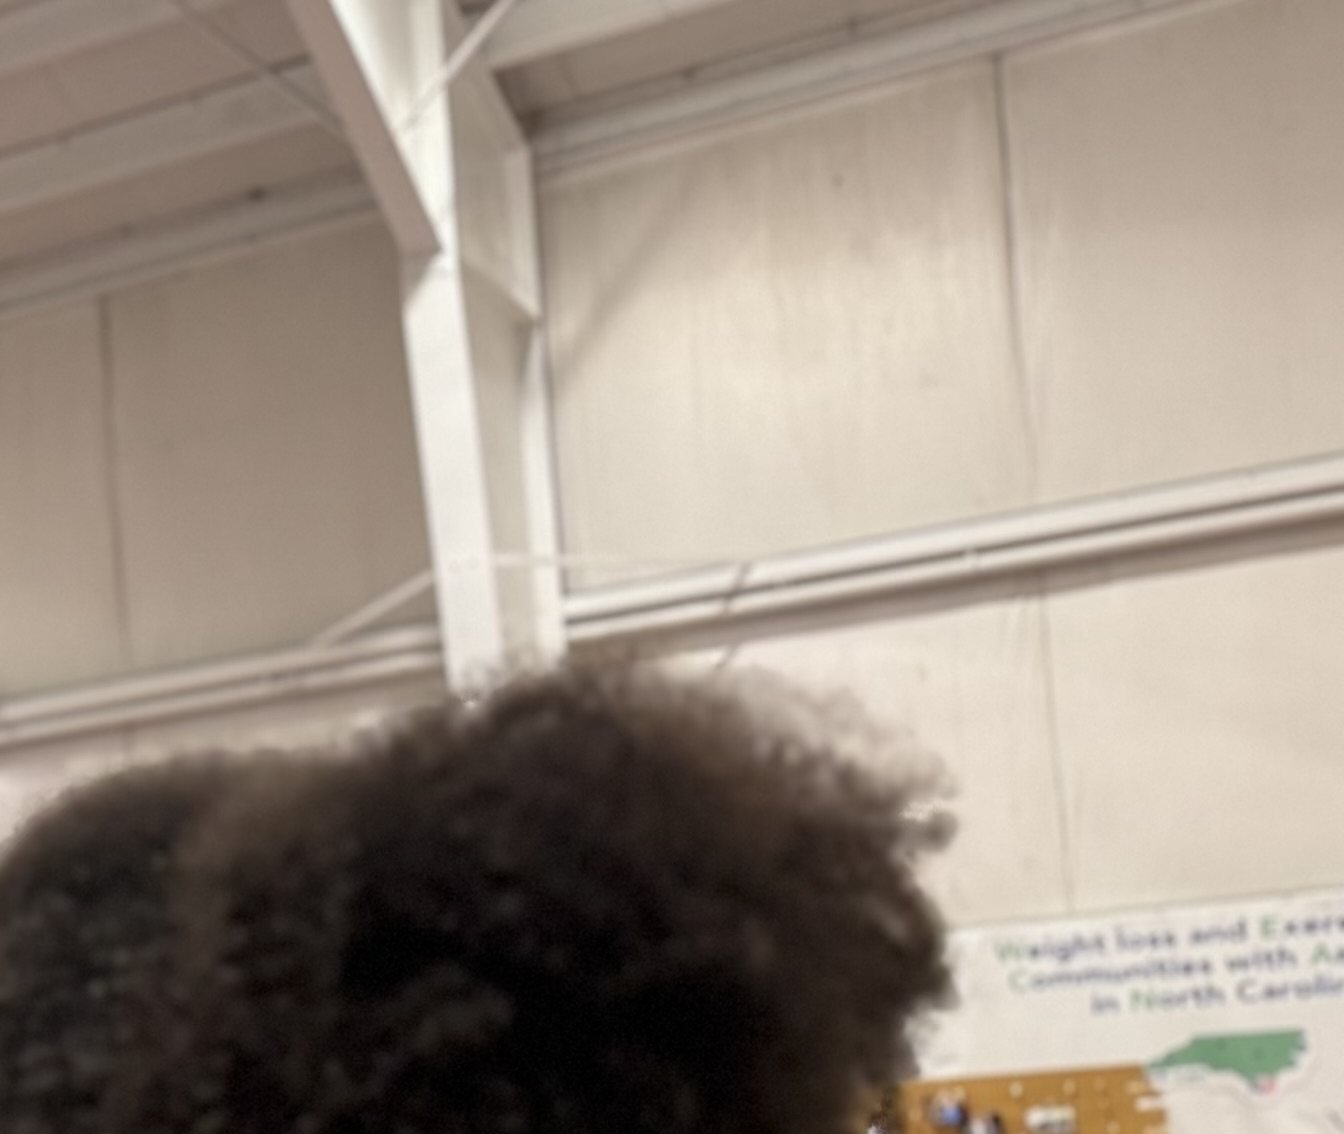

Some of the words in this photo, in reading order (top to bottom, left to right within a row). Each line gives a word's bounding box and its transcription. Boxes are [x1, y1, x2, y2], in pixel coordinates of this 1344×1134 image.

[994, 932, 1106, 964] Weight
[1189, 918, 1248, 945] and
[1007, 956, 1214, 993] Communities
[1226, 947, 1297, 973] with
[1091, 993, 1120, 1015] in
[1130, 983, 1226, 1012] North
